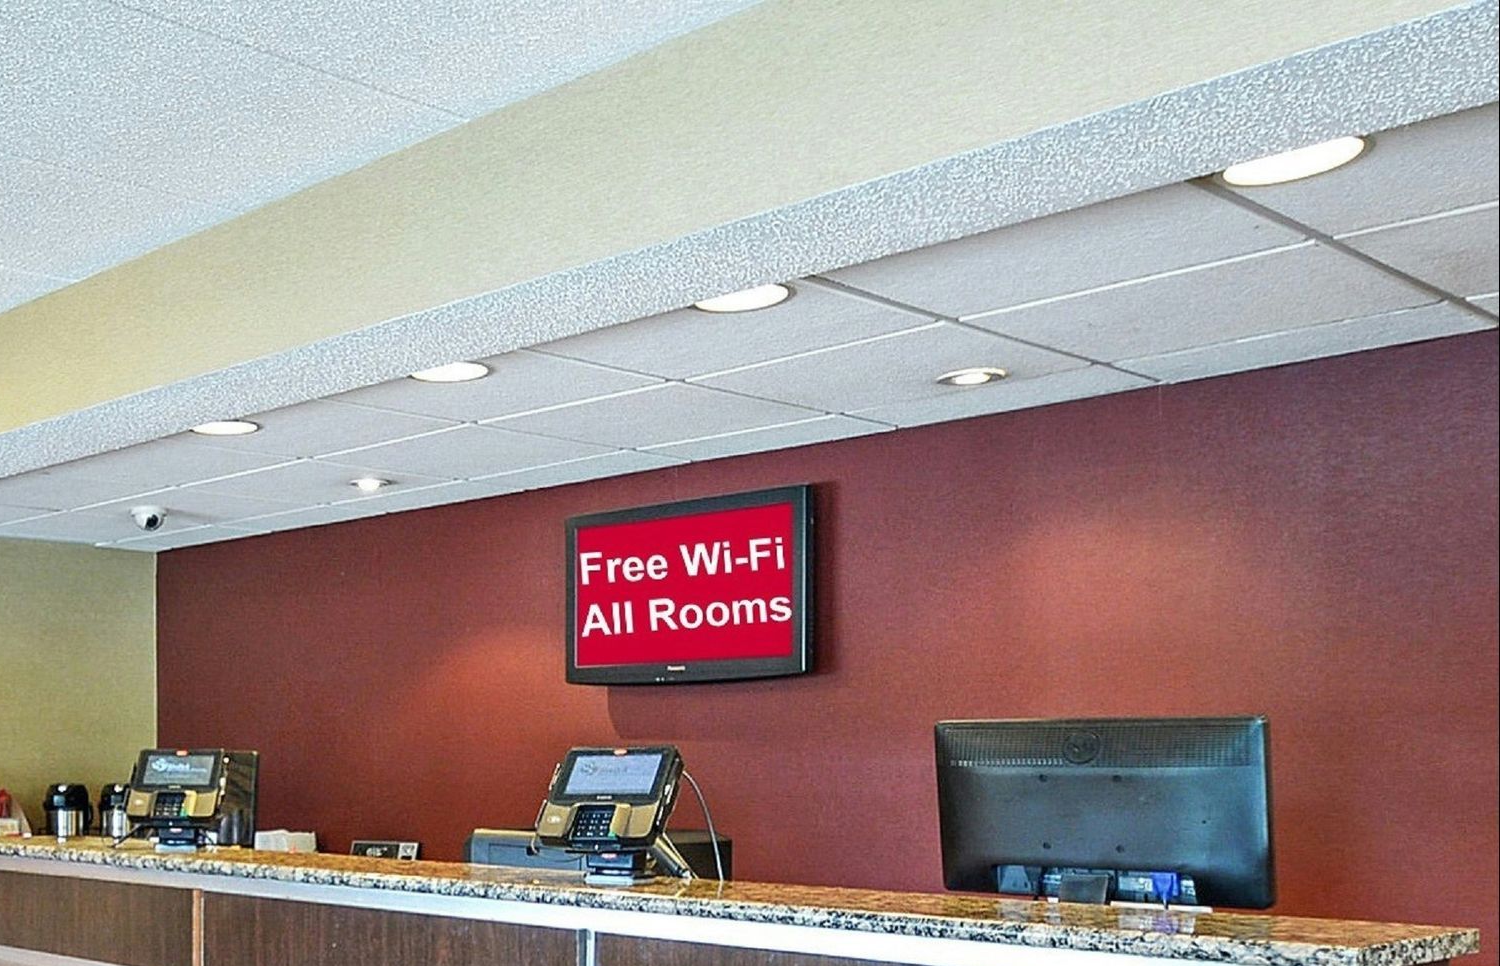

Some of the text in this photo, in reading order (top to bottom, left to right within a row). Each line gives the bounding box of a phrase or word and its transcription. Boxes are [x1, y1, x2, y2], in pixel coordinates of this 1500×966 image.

[579, 536, 785, 585] Free Wi-Fi
[581, 596, 793, 638] All Rooms
